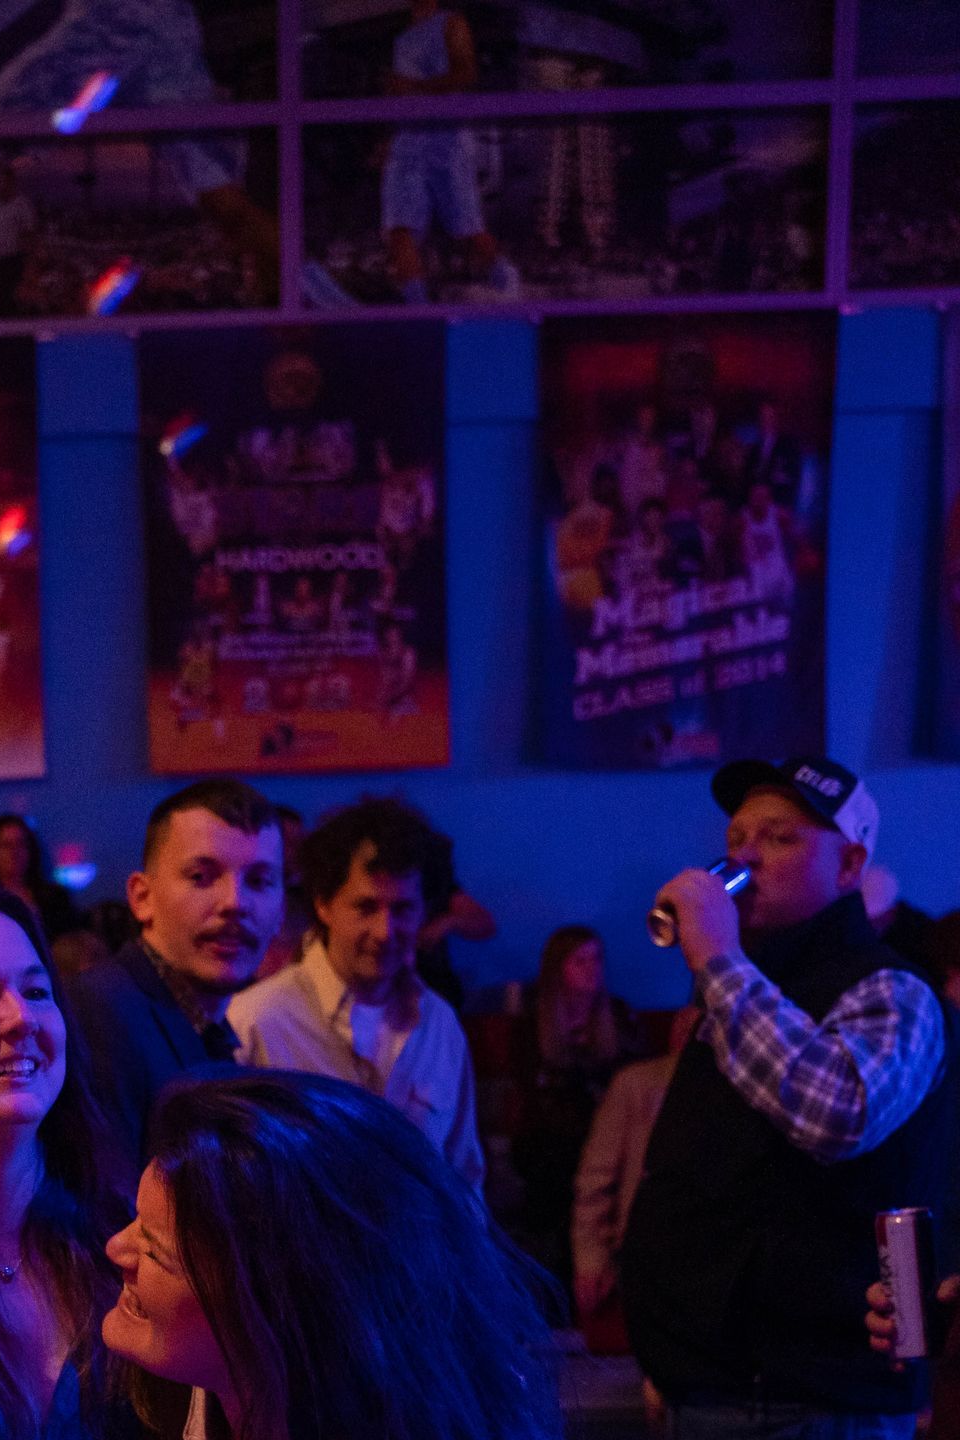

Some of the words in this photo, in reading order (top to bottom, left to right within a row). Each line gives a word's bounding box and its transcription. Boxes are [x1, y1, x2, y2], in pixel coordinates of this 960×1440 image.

[213, 541, 387, 571] HARDWOOD
[592, 568, 764, 637] Magical
[575, 609, 790, 685] Memorable
[572, 676, 676, 722] CLASS
[679, 668, 706, 698] of
[714, 651, 788, 690] 2014
